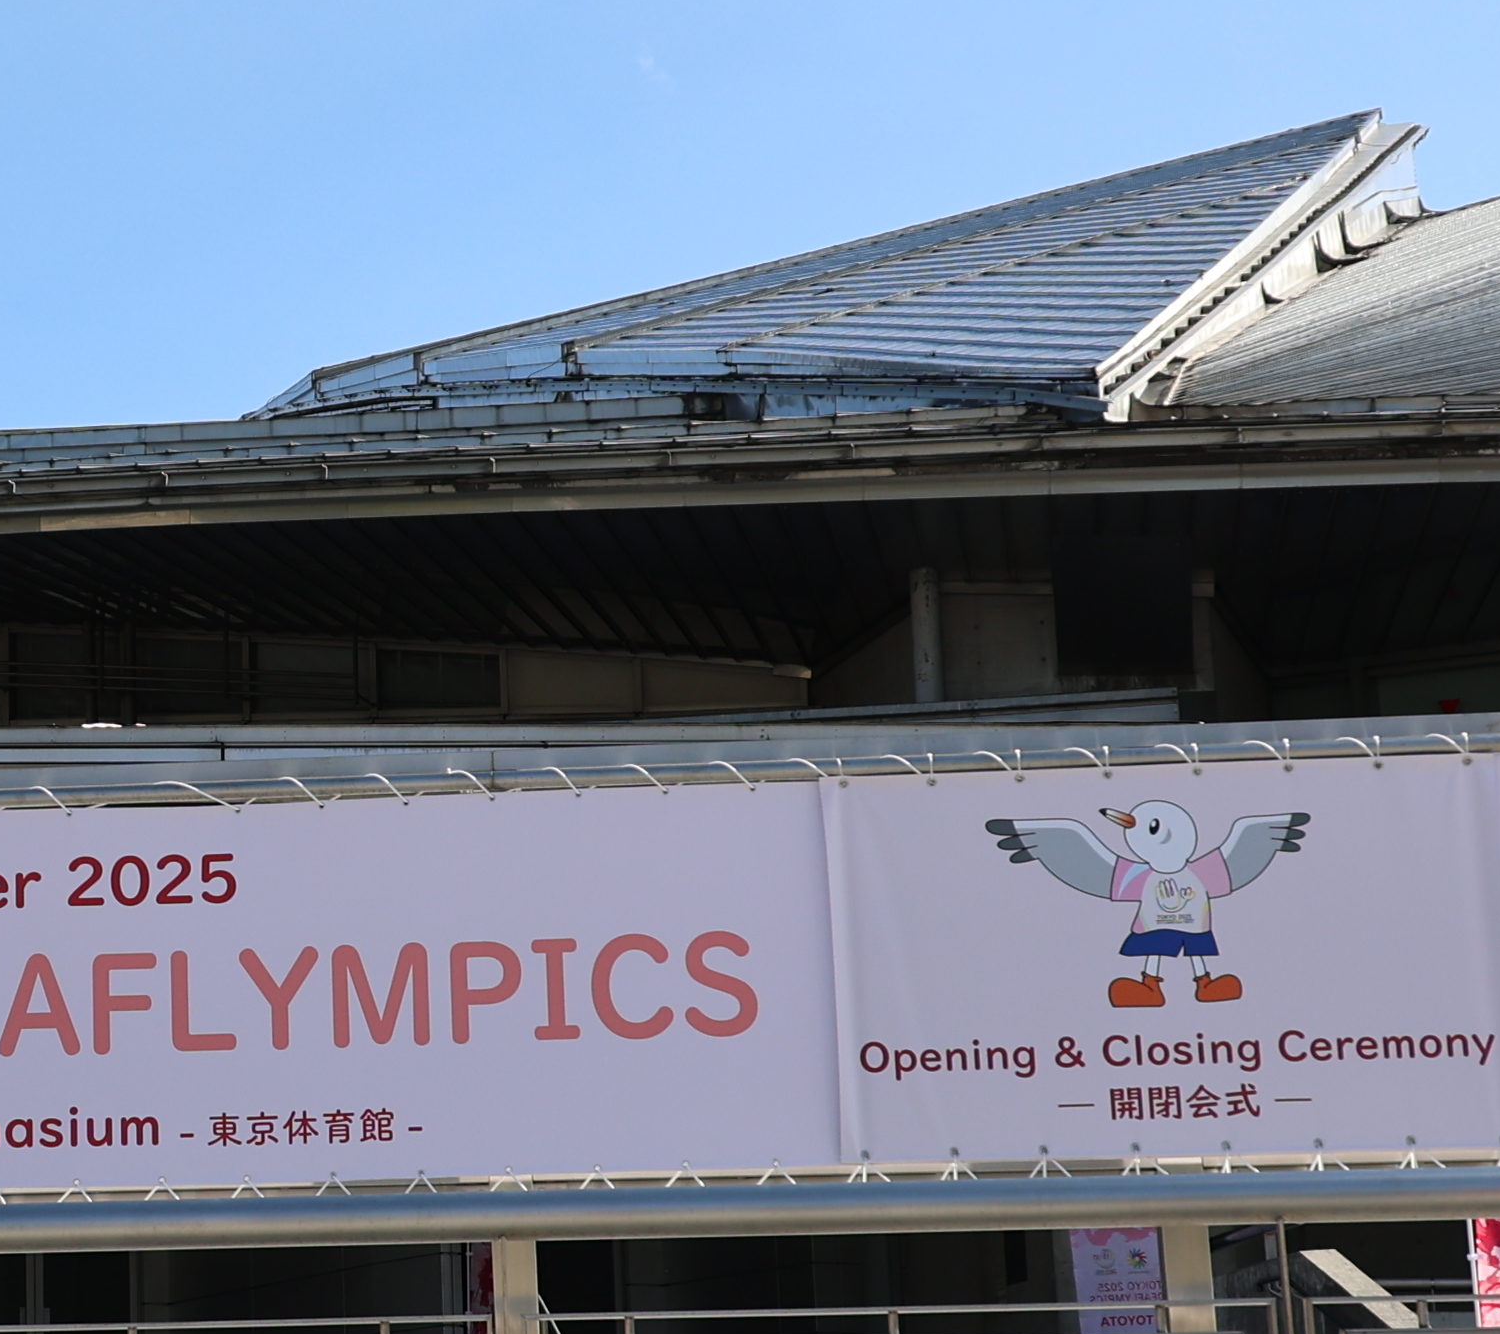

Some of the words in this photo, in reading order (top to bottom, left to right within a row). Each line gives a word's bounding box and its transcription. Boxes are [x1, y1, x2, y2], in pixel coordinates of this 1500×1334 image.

[67, 853, 237, 907] 2025
[859, 1038, 1036, 1082] Opening
[1054, 1036, 1086, 1069] &
[1102, 1032, 1261, 1072] Closing
[1278, 1029, 1495, 1066] Ceremony
[1109, 1083, 1261, 1121] 開閉会式
[207, 1107, 395, 1147] 東京体育館
